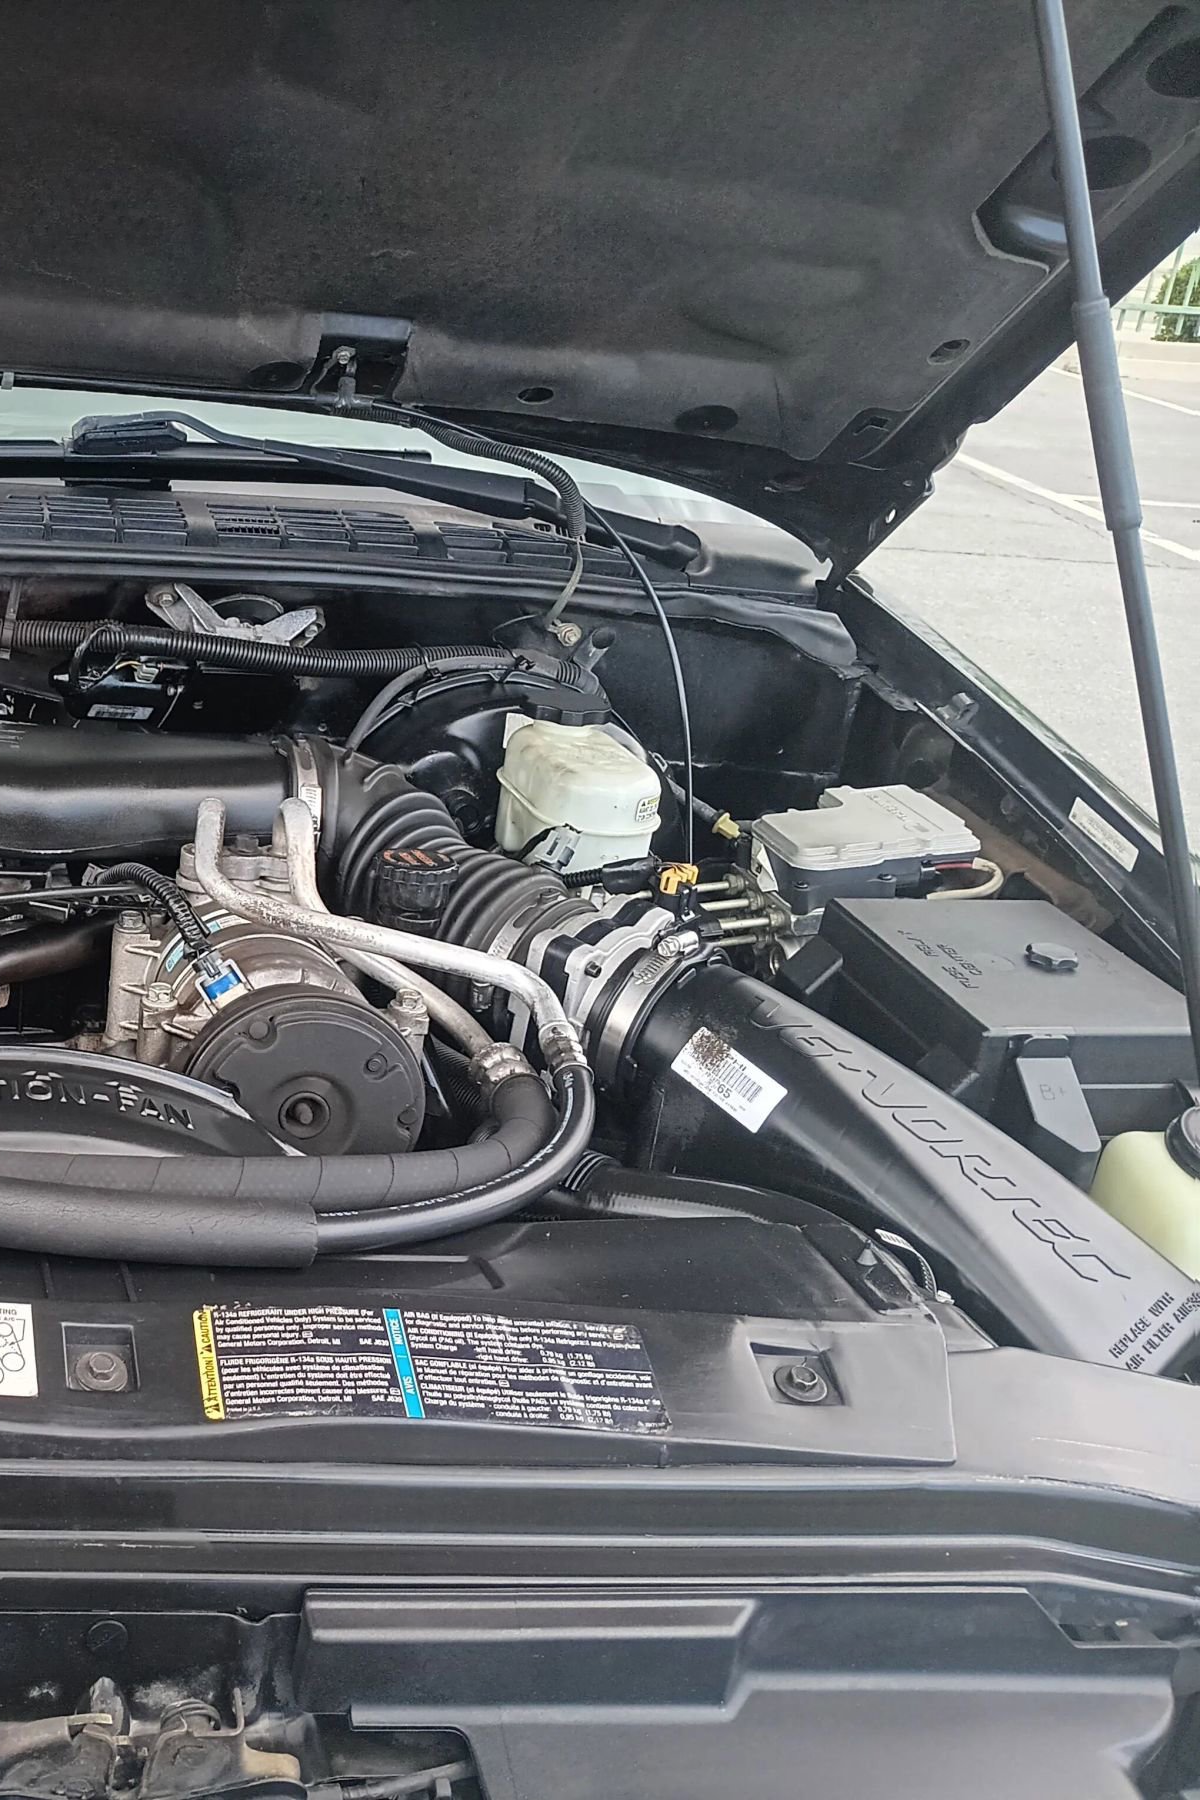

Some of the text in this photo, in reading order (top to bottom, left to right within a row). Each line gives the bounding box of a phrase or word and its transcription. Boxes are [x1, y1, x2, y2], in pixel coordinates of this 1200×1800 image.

[238, 1309, 283, 1317] REFRIGERANT
[284, 1308, 307, 1316] UNDER
[307, 1307, 324, 1315] HIGH
[325, 1307, 359, 1316] PRESSURE
[225, 1317, 265, 1325] Conditioned
[265, 1316, 294, 1324] Vehicles
[294, 1316, 312, 1324] Only)
[312, 1315, 337, 1323] System
[482, 1315, 496, 1323] help
[200, 1311, 211, 1344] CAUTION
[224, 1325, 252, 1333] qualified
[253, 1324, 285, 1332] personnel
[302, 1323, 331, 1331] Improper
[357, 1324, 385, 1332] methods
[1108, 1291, 1175, 1359] REPLACE WITH
[251, 1332, 280, 1340] personal
[391, 1319, 404, 1345] NOTICE
[420, 1328, 465, 1338] CONDITIONING
[217, 1340, 242, 1348] General
[267, 1338, 306, 1347] Corporation,
[307, 1337, 331, 1345] Detroit,
[410, 1341, 458, 1352] System Charge
[1125, 1353, 1145, 1371] AIR
[1142, 1322, 1176, 1355] FILTER
[220, 1358, 244, 1366] FLUIDE
[358, 1356, 392, 1364] PRESSION
[204, 1360, 218, 1402] ATTENTION
[403, 1376, 415, 1395] AVIS
